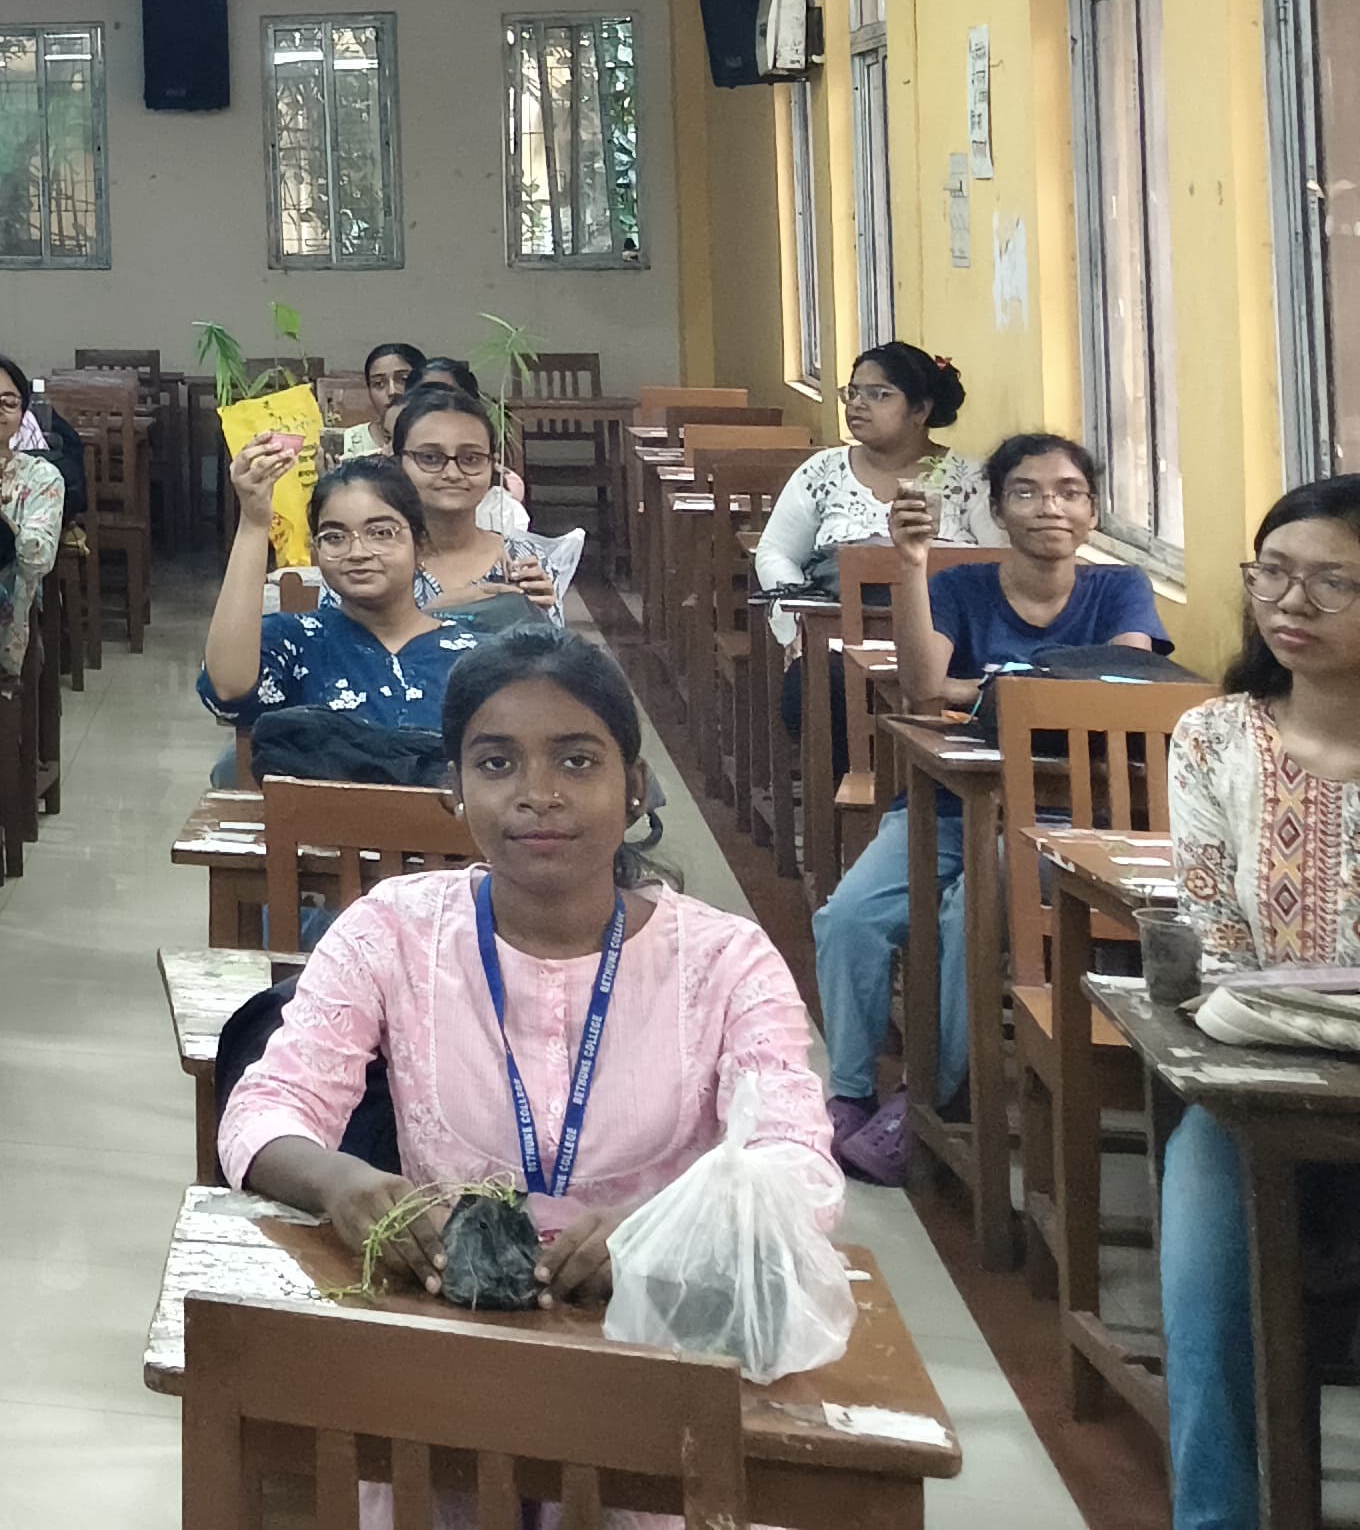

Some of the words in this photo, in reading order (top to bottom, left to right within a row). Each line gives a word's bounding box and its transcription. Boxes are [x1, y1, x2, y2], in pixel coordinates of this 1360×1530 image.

[599, 946, 619, 994] BETHUNE
[572, 1054, 594, 1106] BETHUNE
[583, 1014, 603, 1059] COLLEGE
[513, 1077, 531, 1124] COLLEGE
[520, 1122, 538, 1174] BETHUNE
[557, 1126, 577, 1173] COLLEGE
